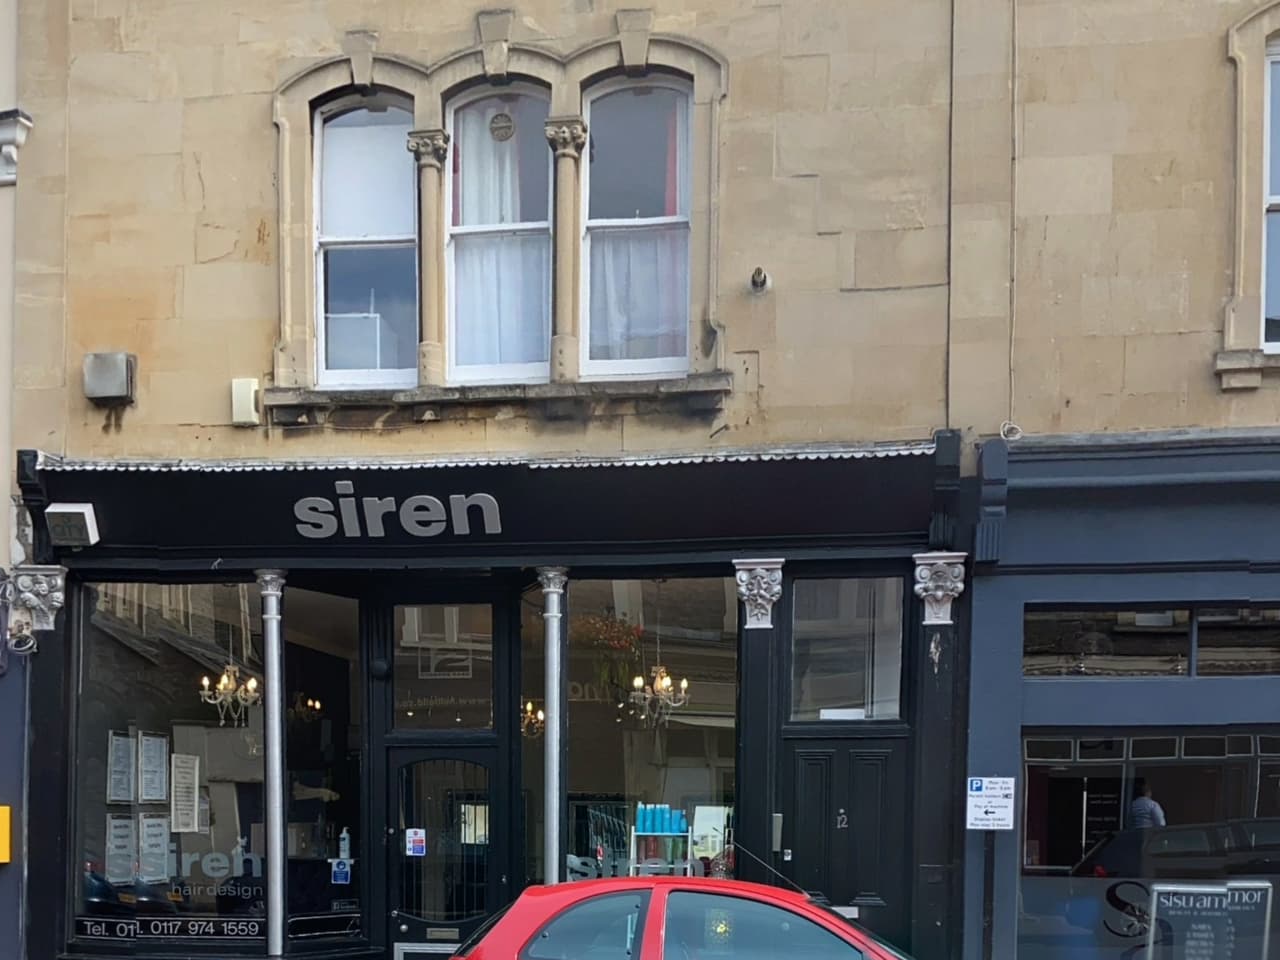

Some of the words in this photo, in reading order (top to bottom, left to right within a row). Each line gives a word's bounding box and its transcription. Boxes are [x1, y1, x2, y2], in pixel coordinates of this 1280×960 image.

[294, 480, 502, 538] siren
[836, 814, 848, 829] 12
[83, 921, 109, 937] Tel.
[150, 920, 182, 935] 0117
[188, 921, 215, 935] 974
[222, 921, 260, 936] 1559
